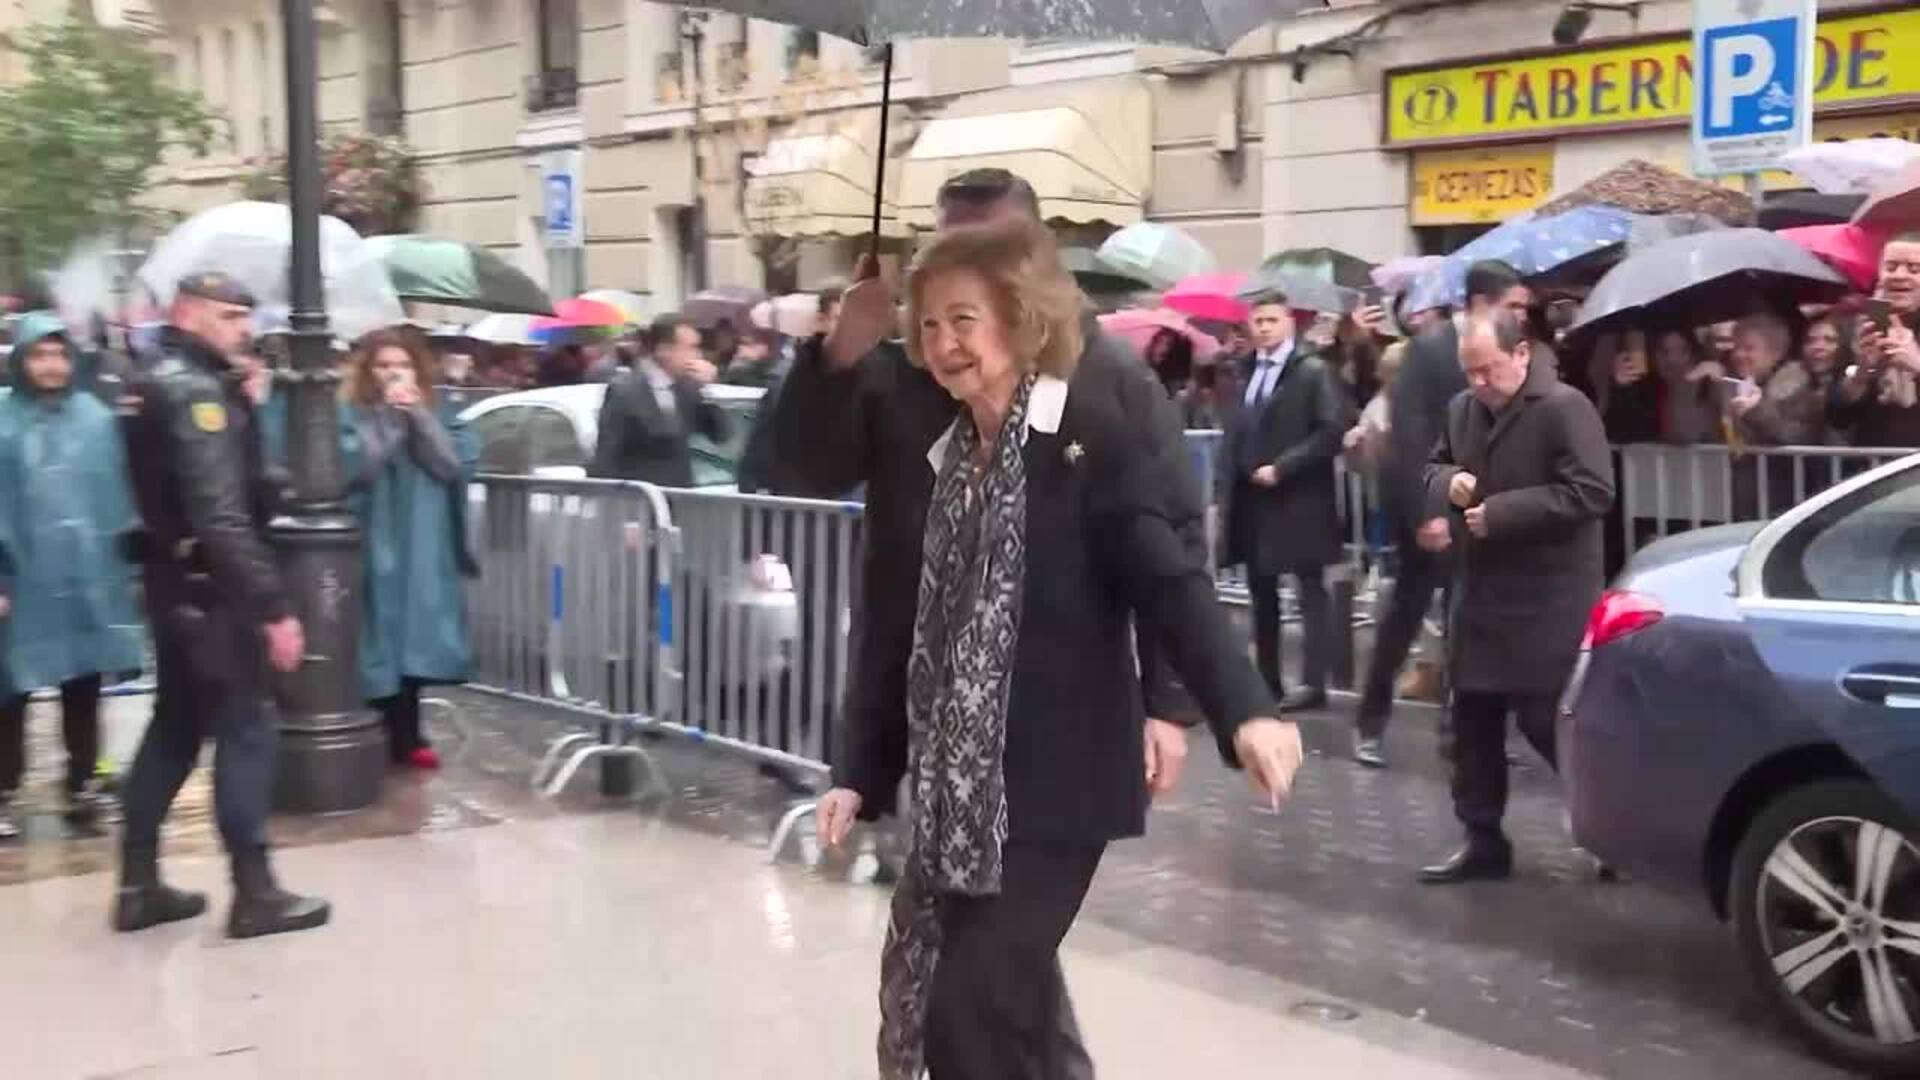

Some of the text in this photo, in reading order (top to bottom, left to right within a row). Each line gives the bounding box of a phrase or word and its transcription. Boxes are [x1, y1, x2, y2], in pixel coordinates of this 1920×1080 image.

[1473, 54, 1693, 124] TABERN
[1710, 33, 1776, 128] P
[1438, 167, 1538, 203] CERVEZAS
